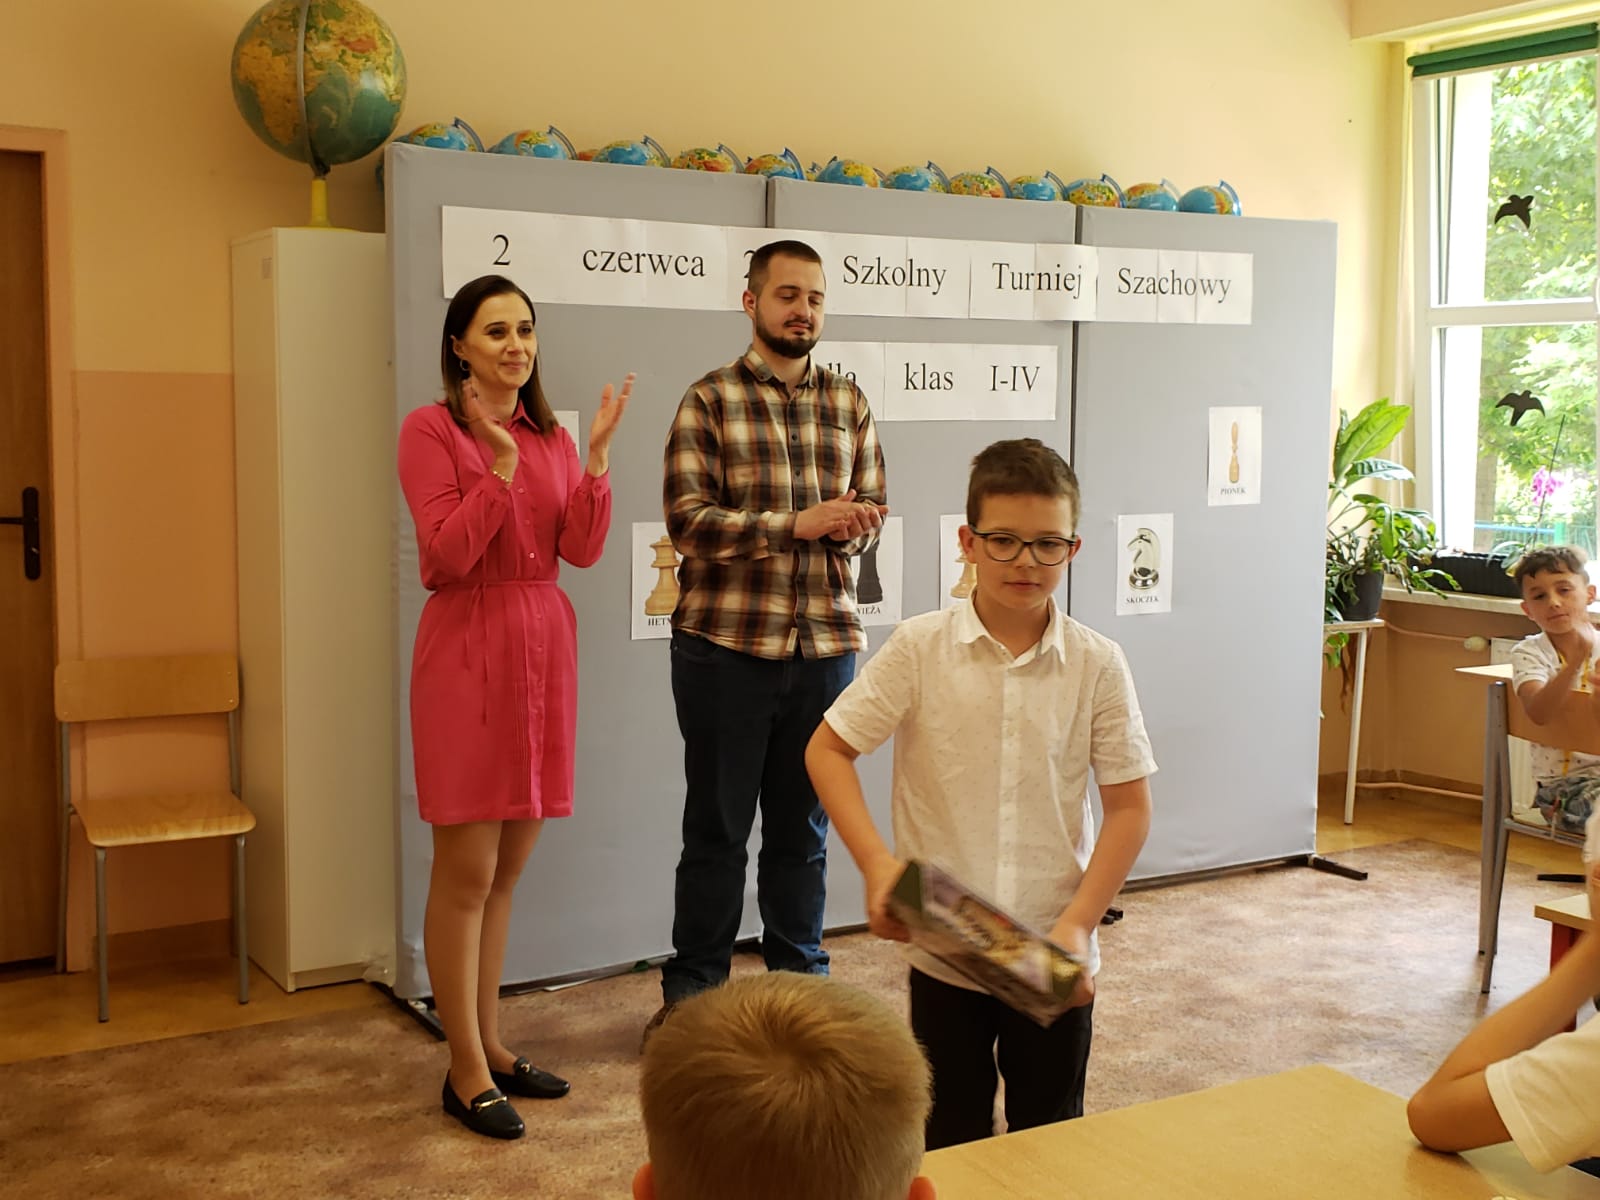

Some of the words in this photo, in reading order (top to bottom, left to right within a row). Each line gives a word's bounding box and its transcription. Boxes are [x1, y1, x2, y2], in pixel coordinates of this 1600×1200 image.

[492, 233, 512, 267] 2
[582, 249, 707, 278] czerwca
[842, 255, 947, 296] Szkolny
[991, 261, 1082, 299] Turniej
[1117, 267, 1232, 304] Szachowy
[903, 361, 954, 391] klas
[989, 364, 1041, 393] I-IV
[1220, 487, 1246, 496] PIONEK
